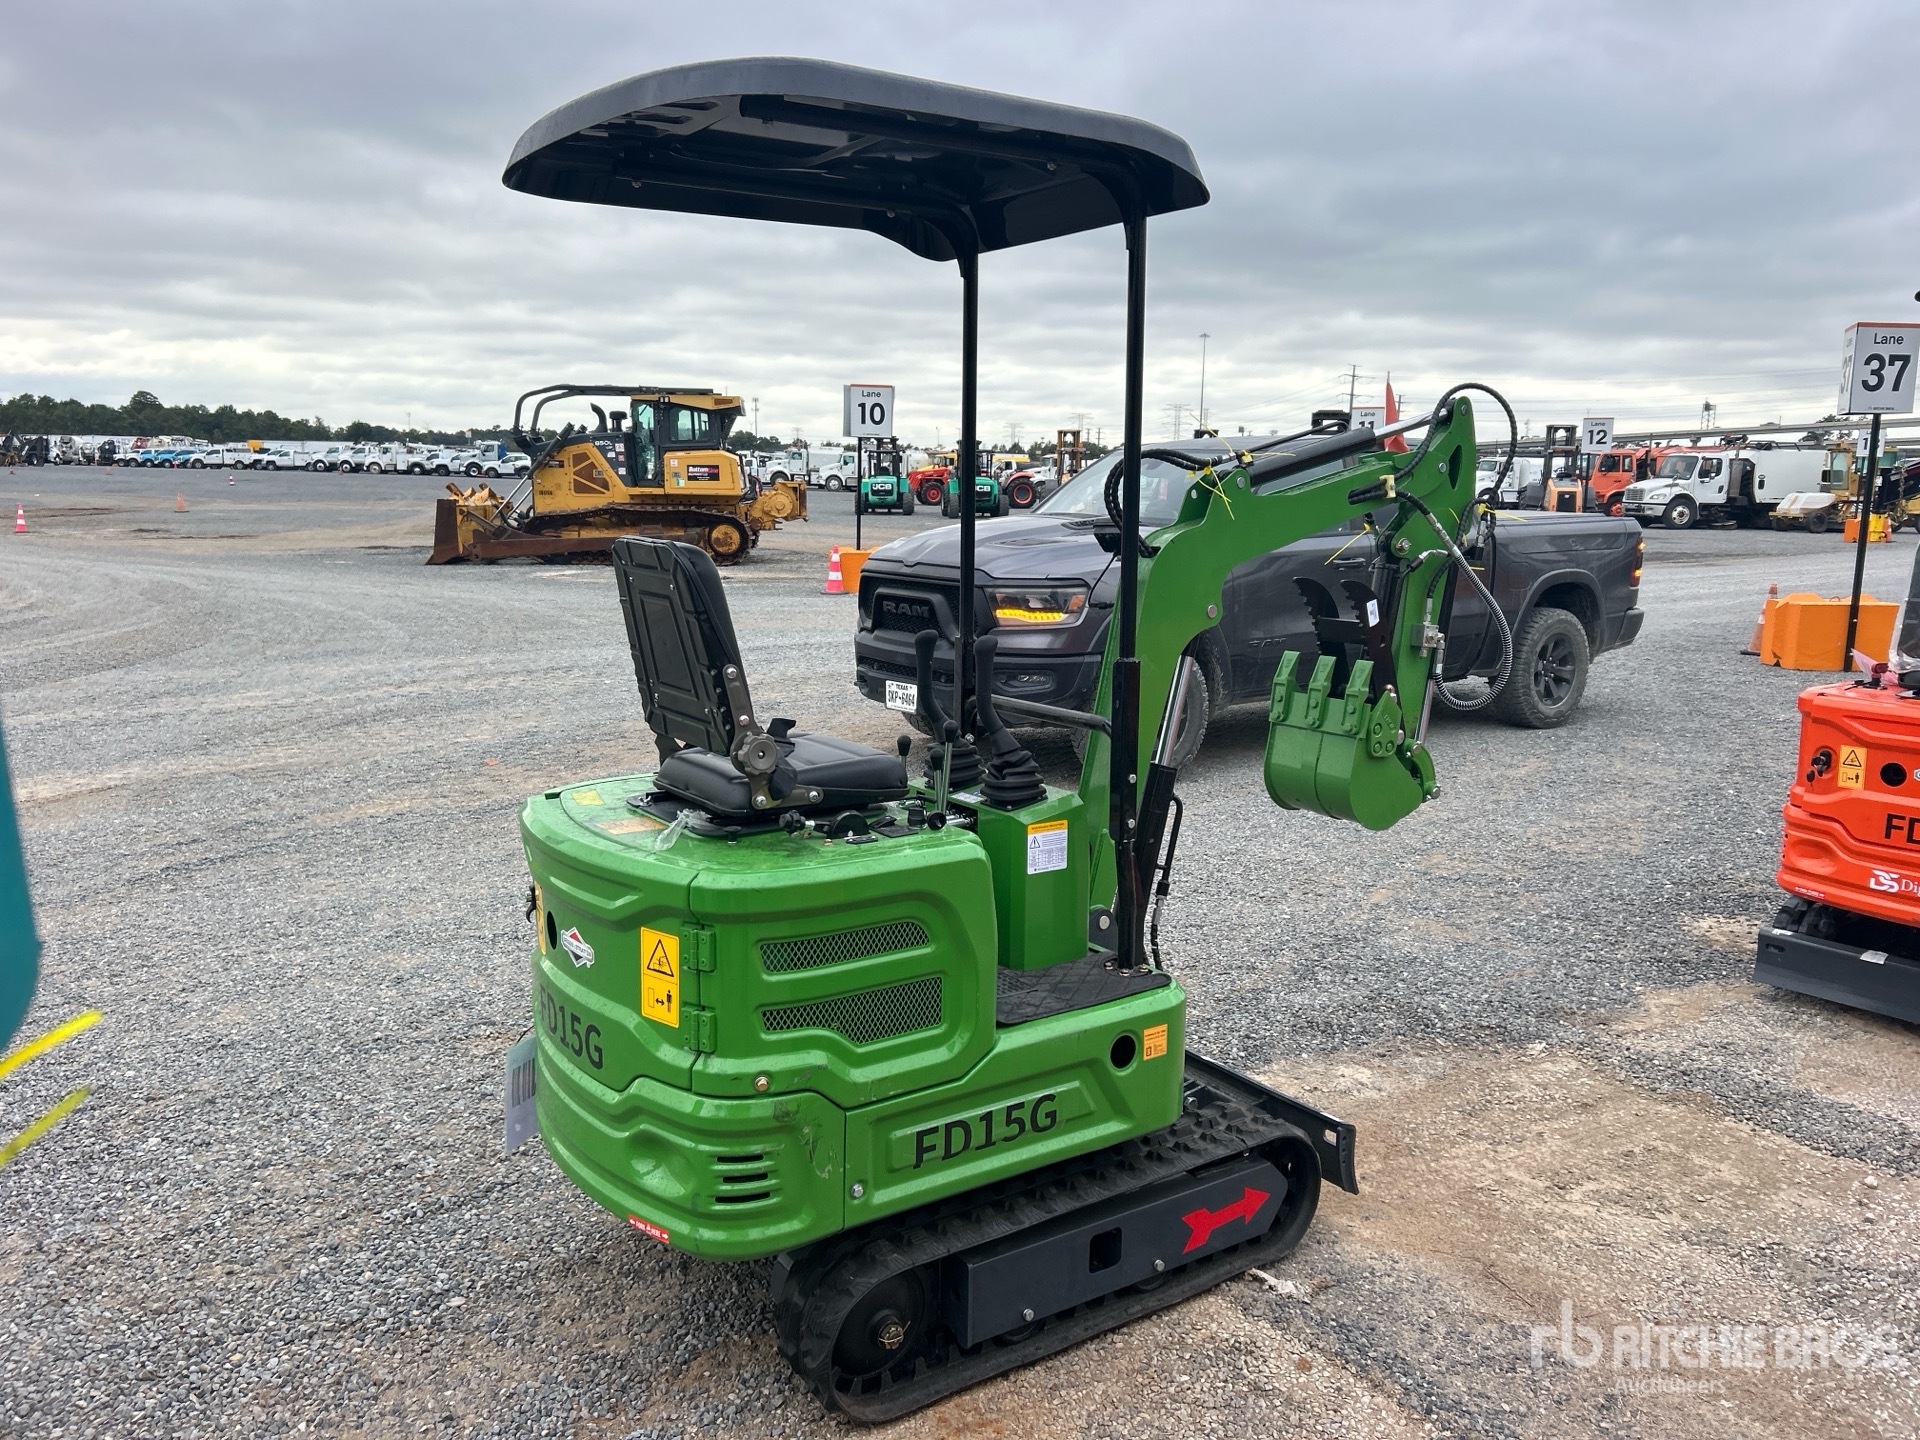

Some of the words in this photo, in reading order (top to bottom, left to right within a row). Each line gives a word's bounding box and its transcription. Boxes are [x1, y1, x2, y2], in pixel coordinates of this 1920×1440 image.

[1873, 333, 1905, 345] Lane
[1861, 352, 1912, 392] 37
[862, 390, 882, 398] Lane
[857, 402, 886, 426] 10
[1588, 429, 1608, 445] 12
[882, 600, 930, 618] RAM
[1901, 878, 1920, 898] Di
[539, 984, 604, 1070] FD15G
[913, 1093, 1057, 1170] FD15G
